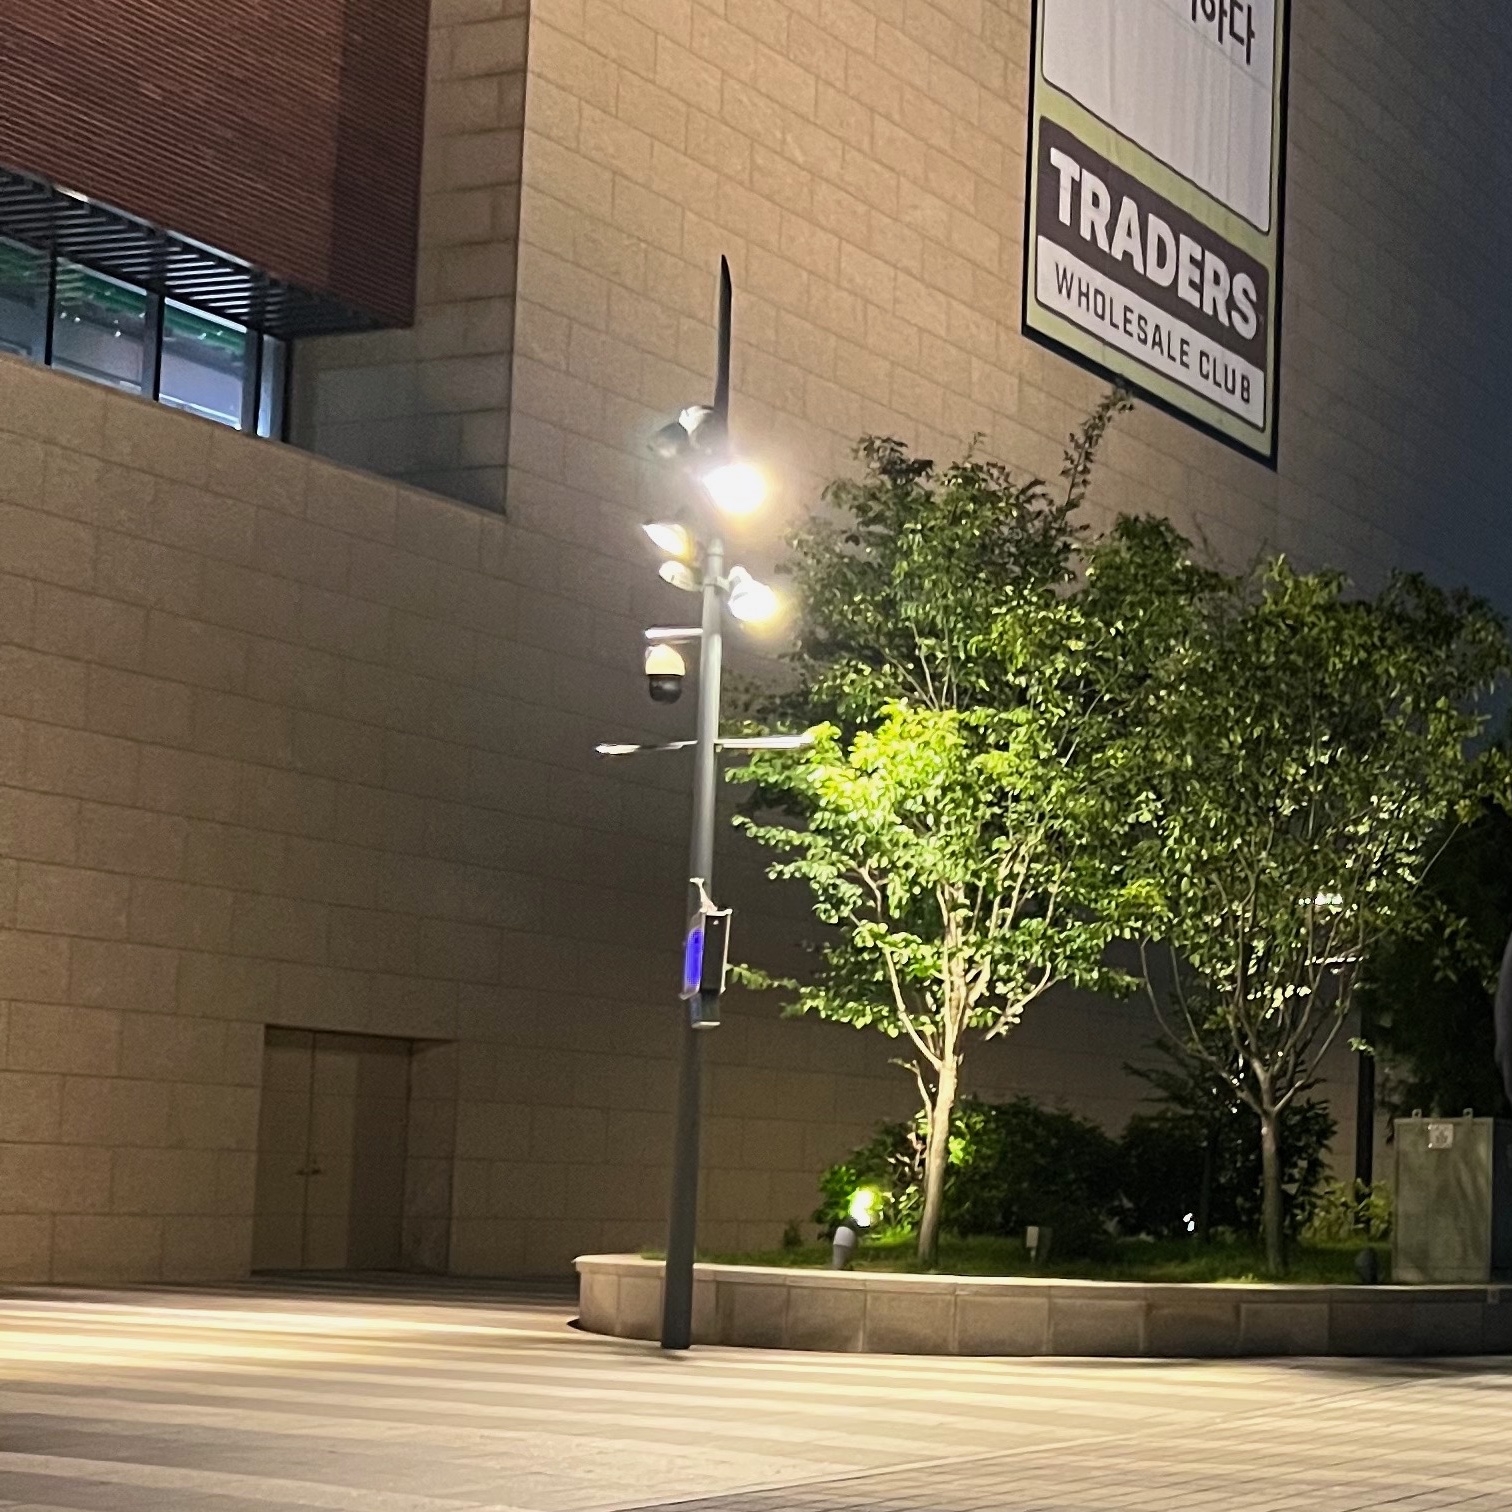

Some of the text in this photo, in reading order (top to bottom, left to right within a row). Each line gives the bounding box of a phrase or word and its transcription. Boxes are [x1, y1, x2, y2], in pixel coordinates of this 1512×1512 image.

[1050, 147, 1258, 340] TRADERS
[1054, 262, 1251, 404] WHOLESALE CLUB
